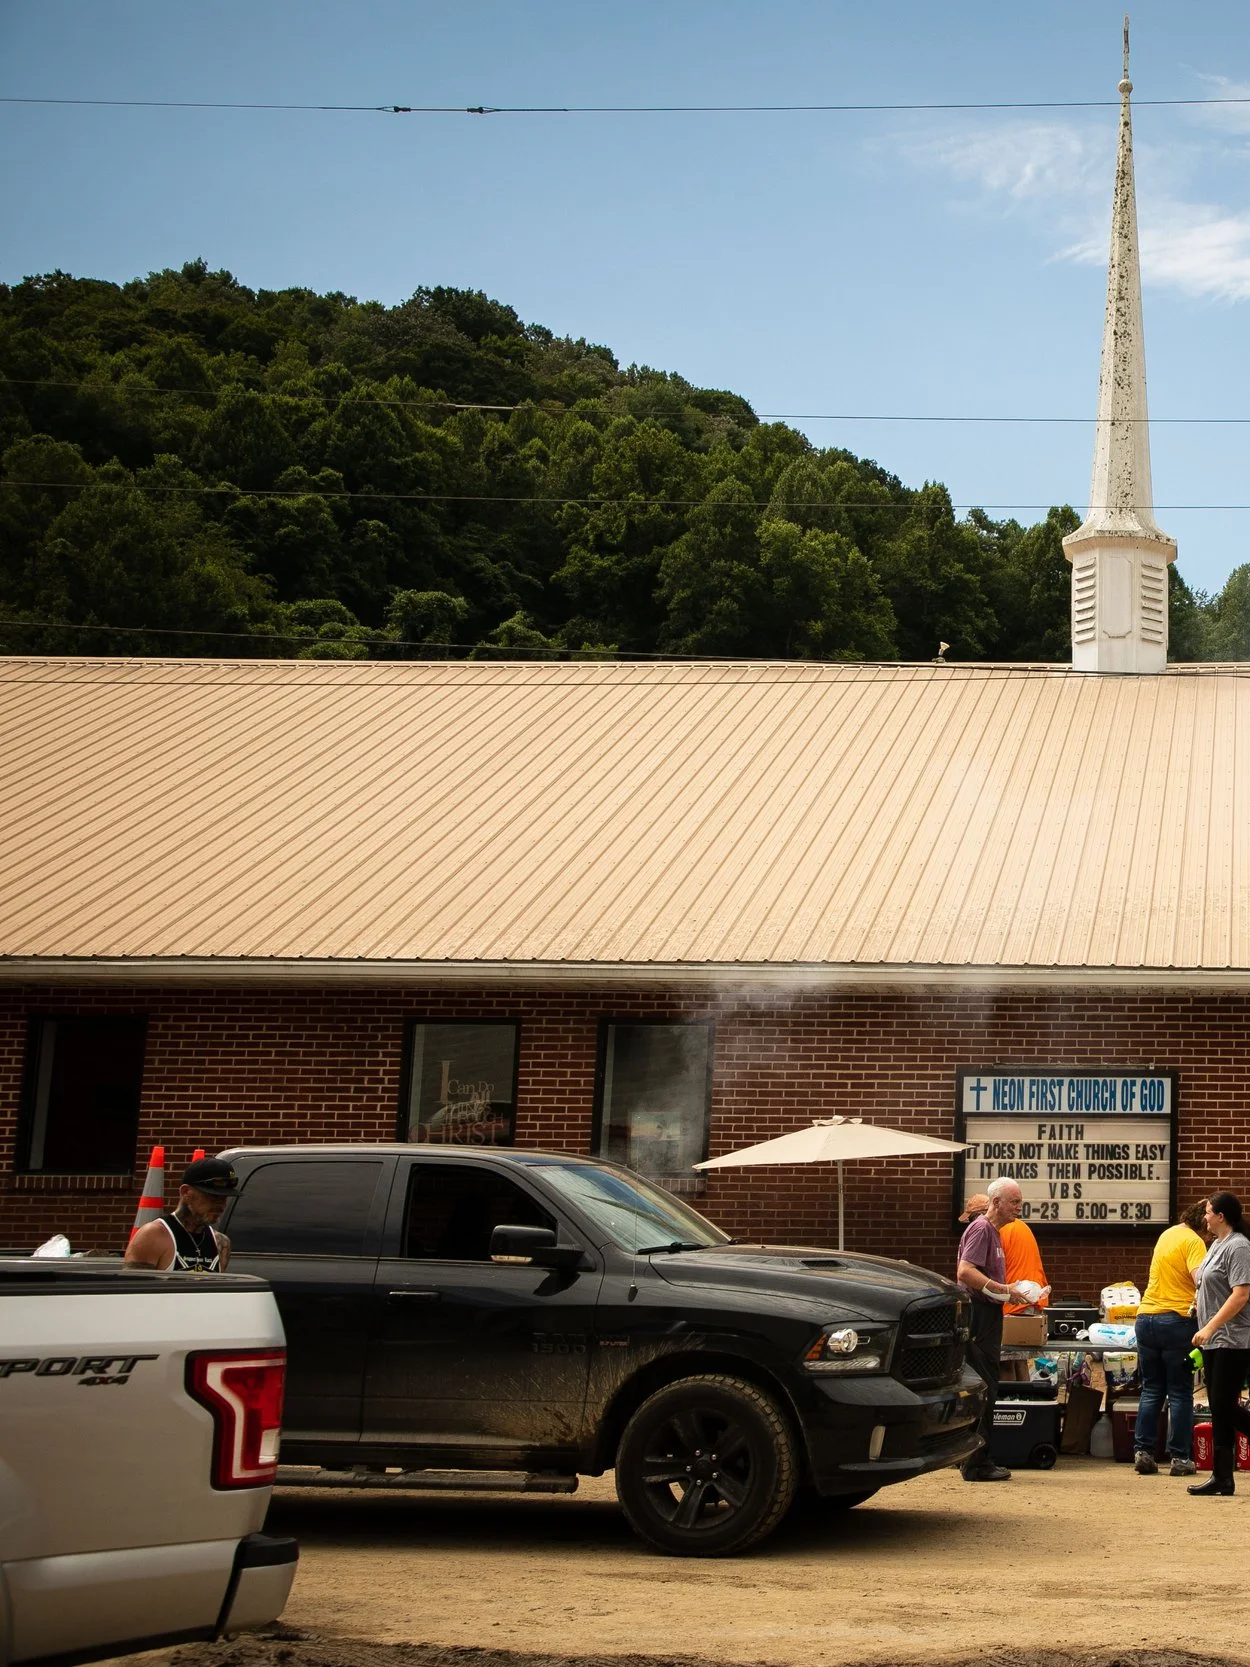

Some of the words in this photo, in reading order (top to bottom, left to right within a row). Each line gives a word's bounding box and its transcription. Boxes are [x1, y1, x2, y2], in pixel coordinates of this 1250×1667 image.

[448, 1079, 475, 1095] Can
[478, 1080, 494, 1092] Do
[993, 1078, 1025, 1111] NEON
[1029, 1078, 1064, 1111] FIRST
[1068, 1079, 1116, 1111] CHURCH
[1121, 1080, 1136, 1111] OF
[1140, 1080, 1165, 1112] GOD
[1038, 1124, 1084, 1141] FAITH
[967, 1143, 980, 1160] IT
[984, 1143, 1015, 1160] DOES
[1019, 1143, 1043, 1160] NOT
[1048, 1144, 1079, 1160] MAKE
[1085, 1144, 1130, 1161] THINGS
[1135, 1144, 1166, 1161] EASY
[980, 1162, 994, 1179] IT
[998, 1163, 1038, 1179] MAKES
[1047, 1163, 1081, 1180] THEM
[1088, 1163, 1161, 1181] POSSIBLE.
[1018, 1202, 1059, 1219] 0-23
